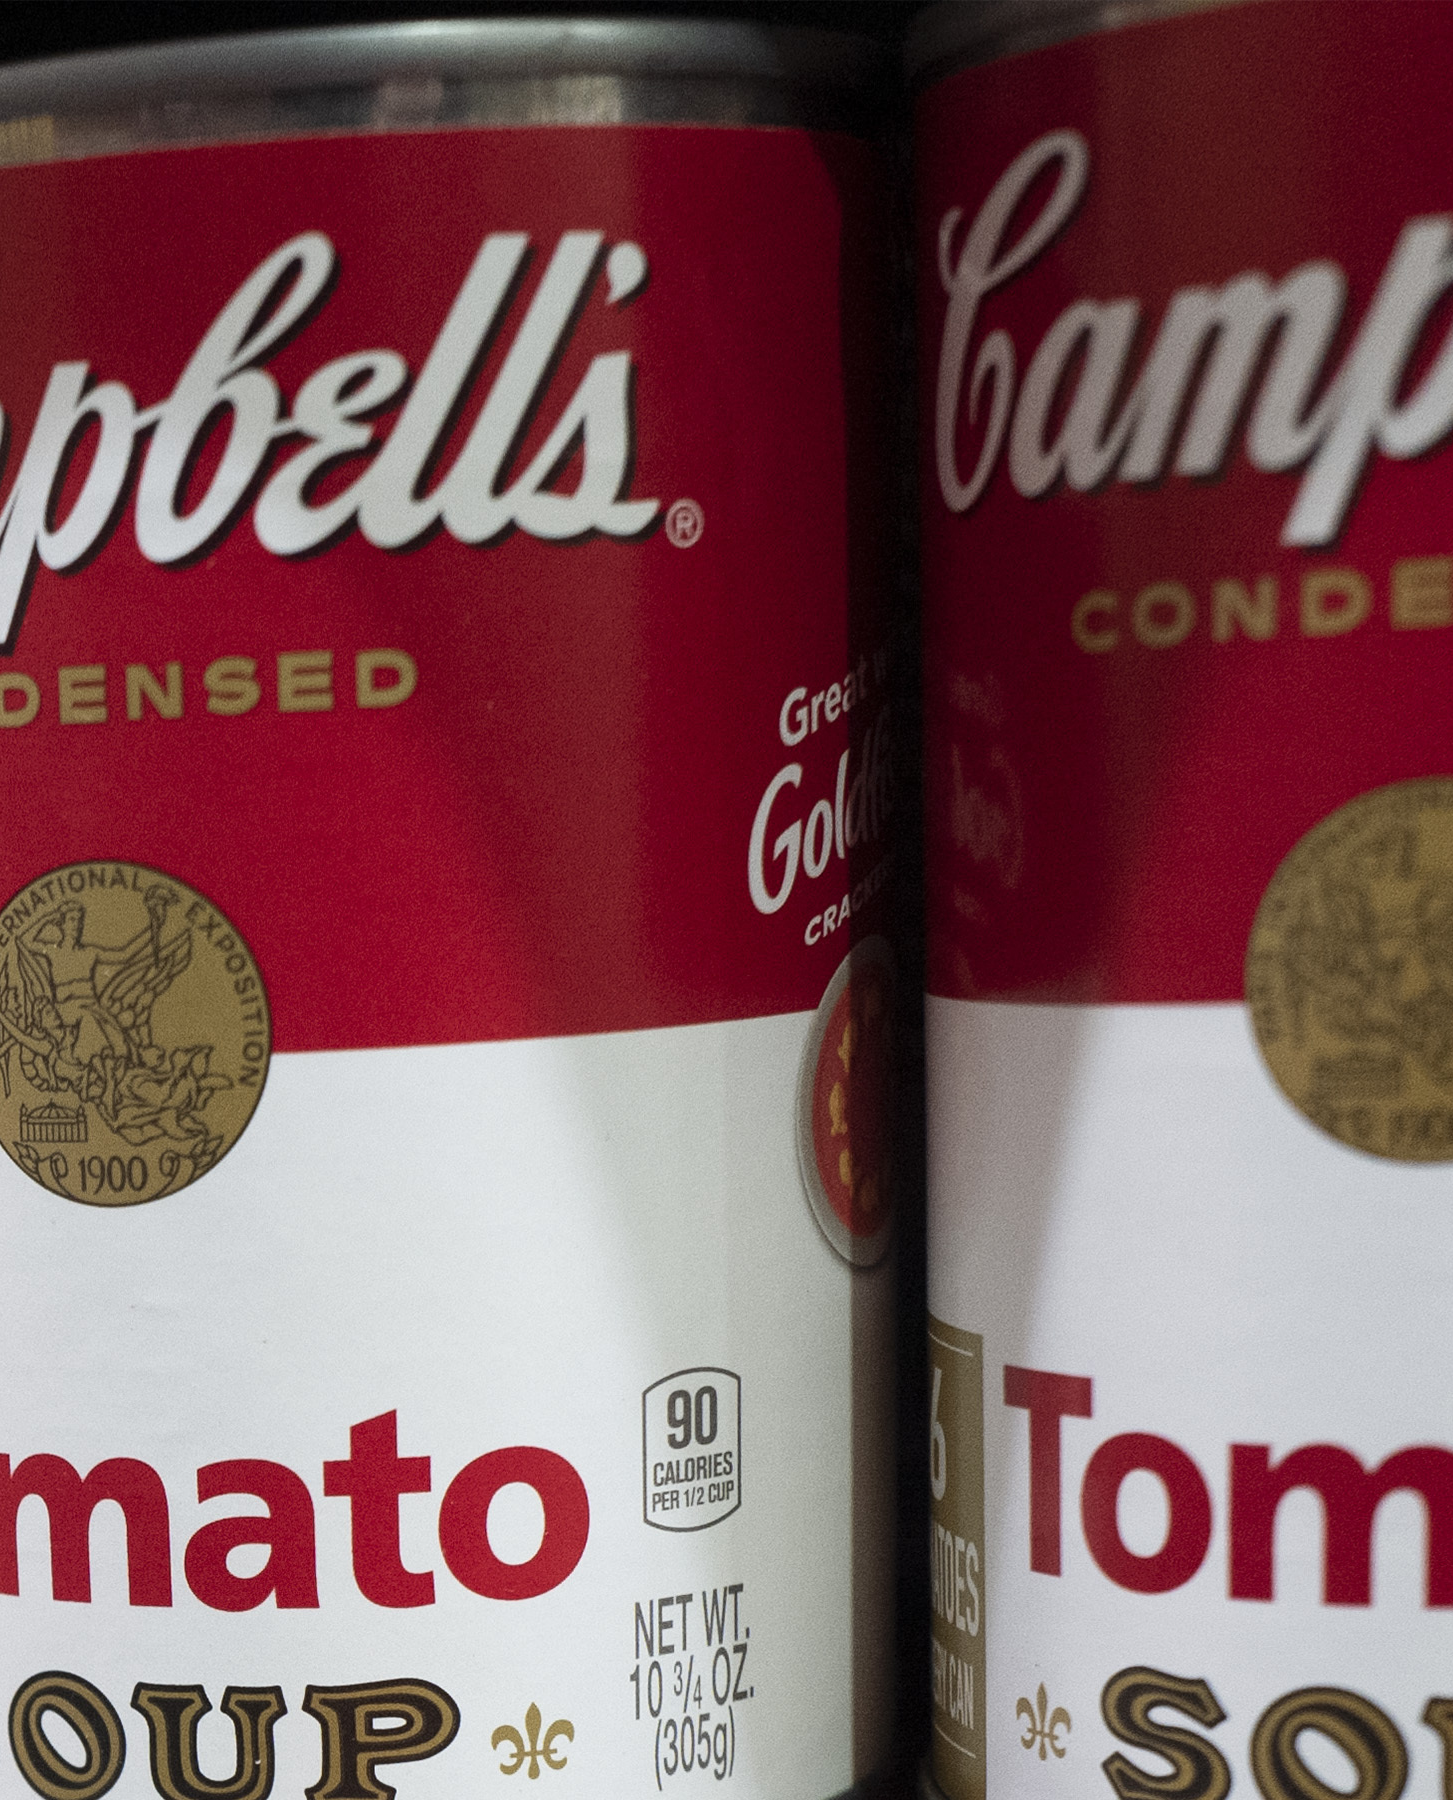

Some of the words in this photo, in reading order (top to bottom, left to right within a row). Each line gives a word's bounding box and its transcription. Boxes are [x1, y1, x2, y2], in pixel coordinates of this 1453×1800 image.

[185, 900, 265, 1088] EXPOSITION
[77, 1154, 150, 1195] 1900
[667, 1385, 718, 1450] 90
[652, 1489, 680, 1512] PER
[683, 1487, 705, 1508] 1/2
[708, 1480, 735, 1504] CUP
[653, 1451, 733, 1487] CALORIES
[635, 1593, 693, 1659] NET
[702, 1583, 750, 1647] WT.
[630, 1660, 663, 1720] 10
[712, 1642, 755, 1706] OZ.
[655, 1704, 736, 1792] (305g)
